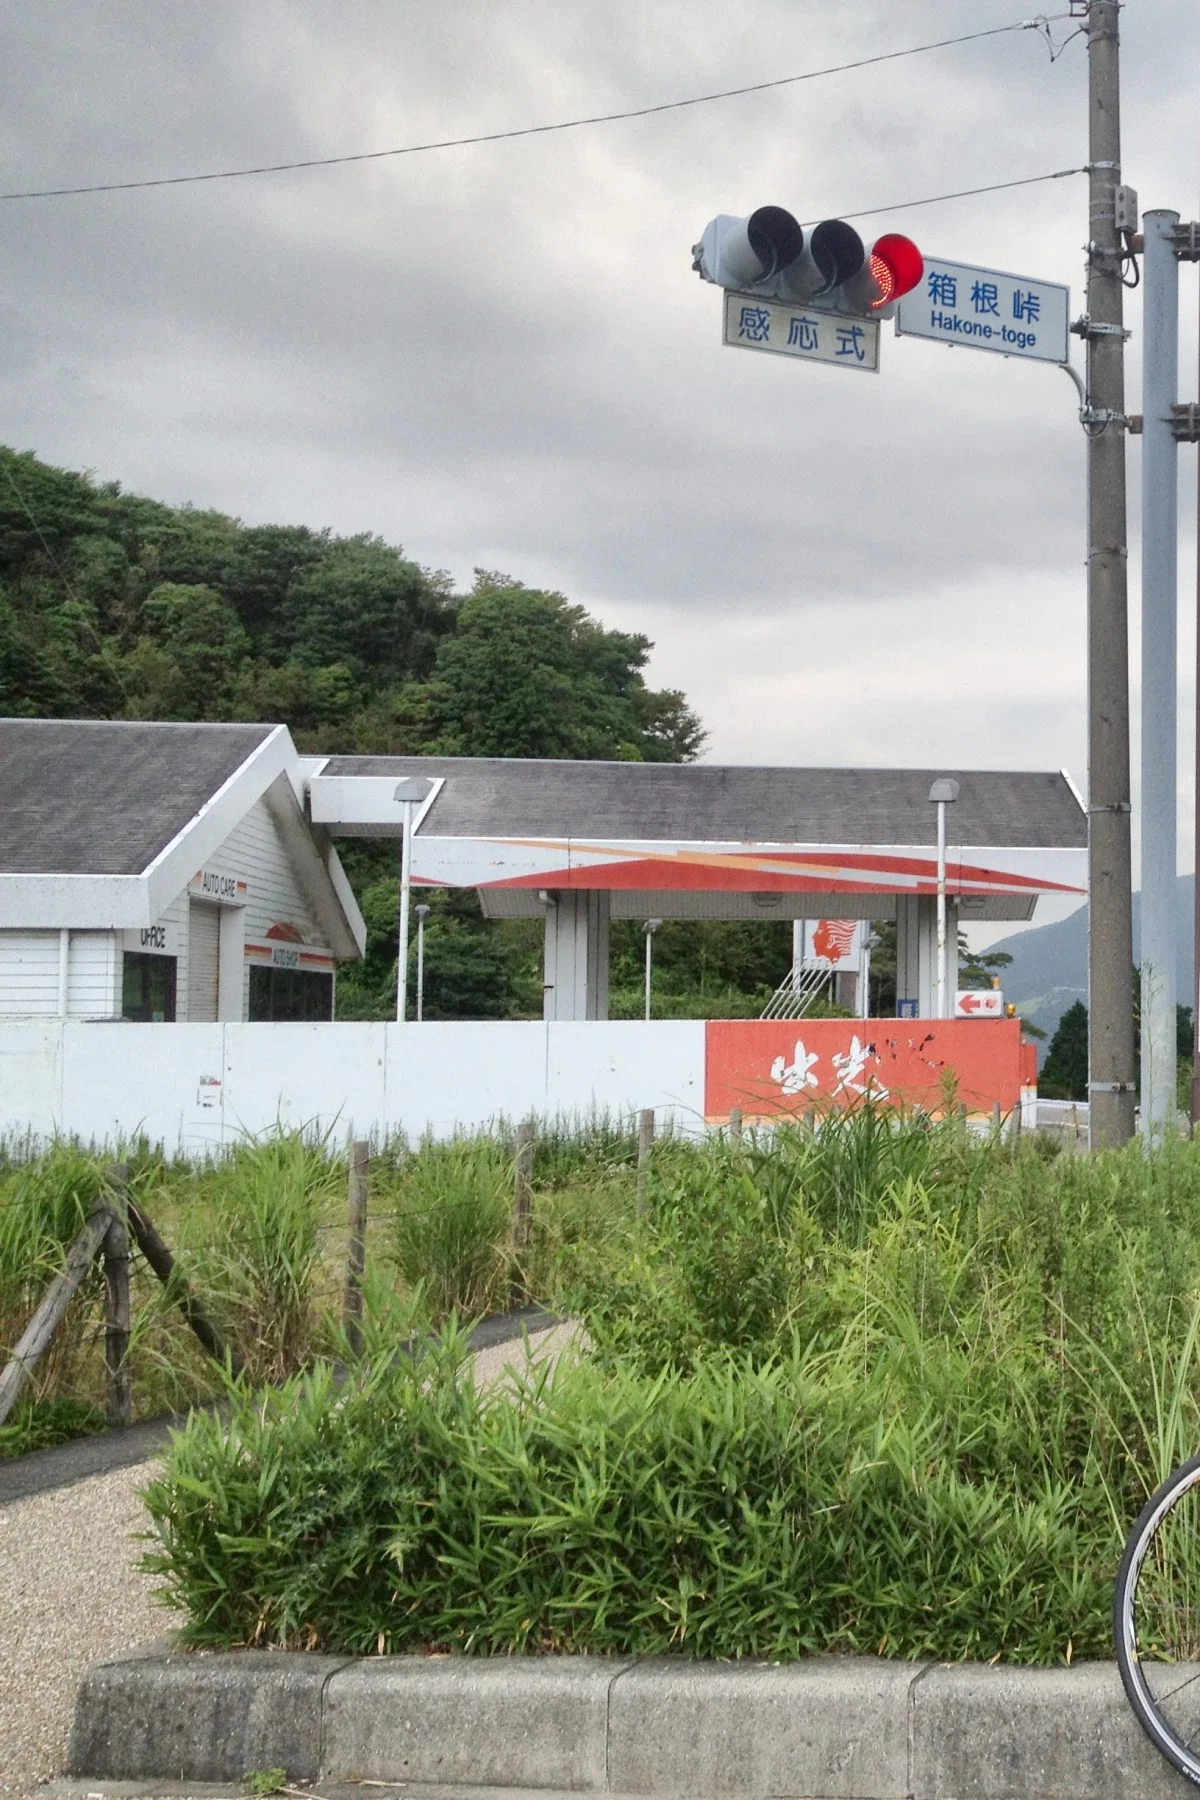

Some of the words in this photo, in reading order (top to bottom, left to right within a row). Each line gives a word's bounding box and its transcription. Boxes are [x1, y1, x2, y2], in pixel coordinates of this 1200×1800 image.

[928, 271, 1041, 325] 箱根峠
[738, 307, 865, 361] 感応式
[930, 310, 1036, 350] Hakone-toge
